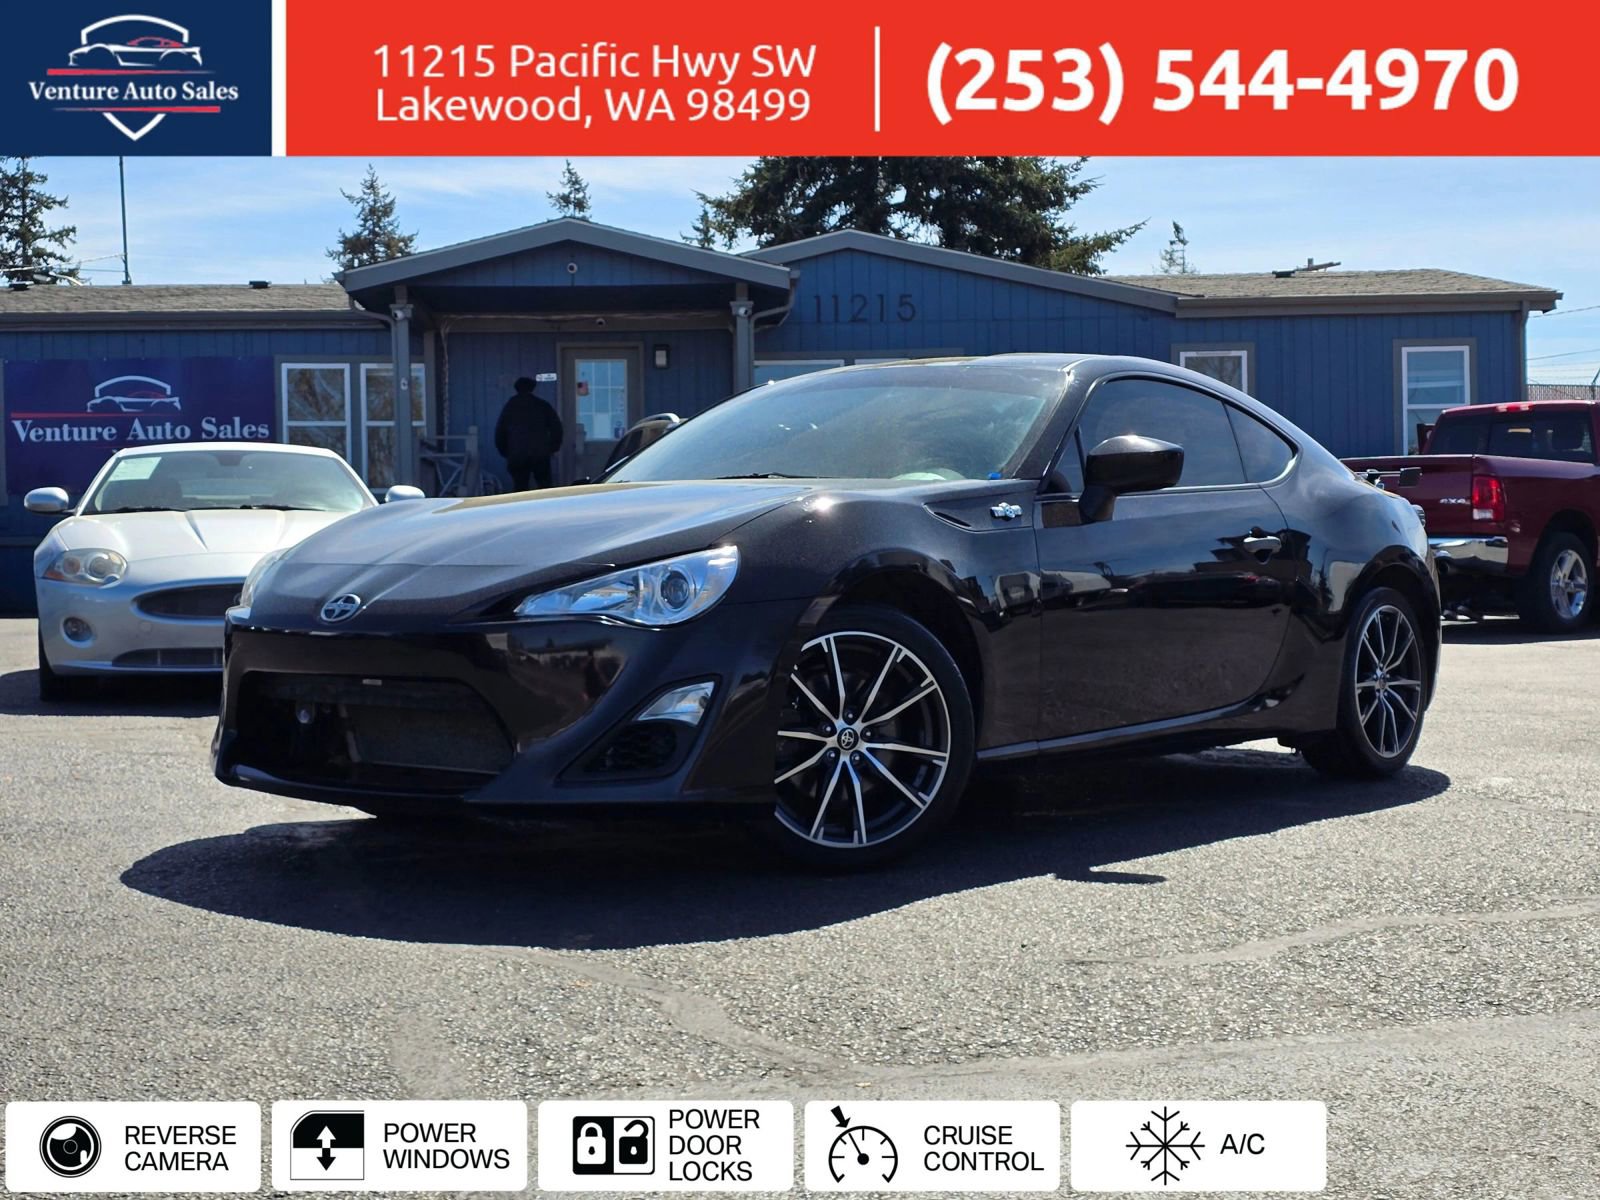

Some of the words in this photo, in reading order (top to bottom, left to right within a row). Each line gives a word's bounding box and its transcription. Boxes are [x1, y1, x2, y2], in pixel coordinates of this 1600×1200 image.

[814, 294, 916, 322] 11215
[12, 419, 117, 442] Venture
[127, 417, 191, 440] Auto
[201, 416, 269, 439] Sales
